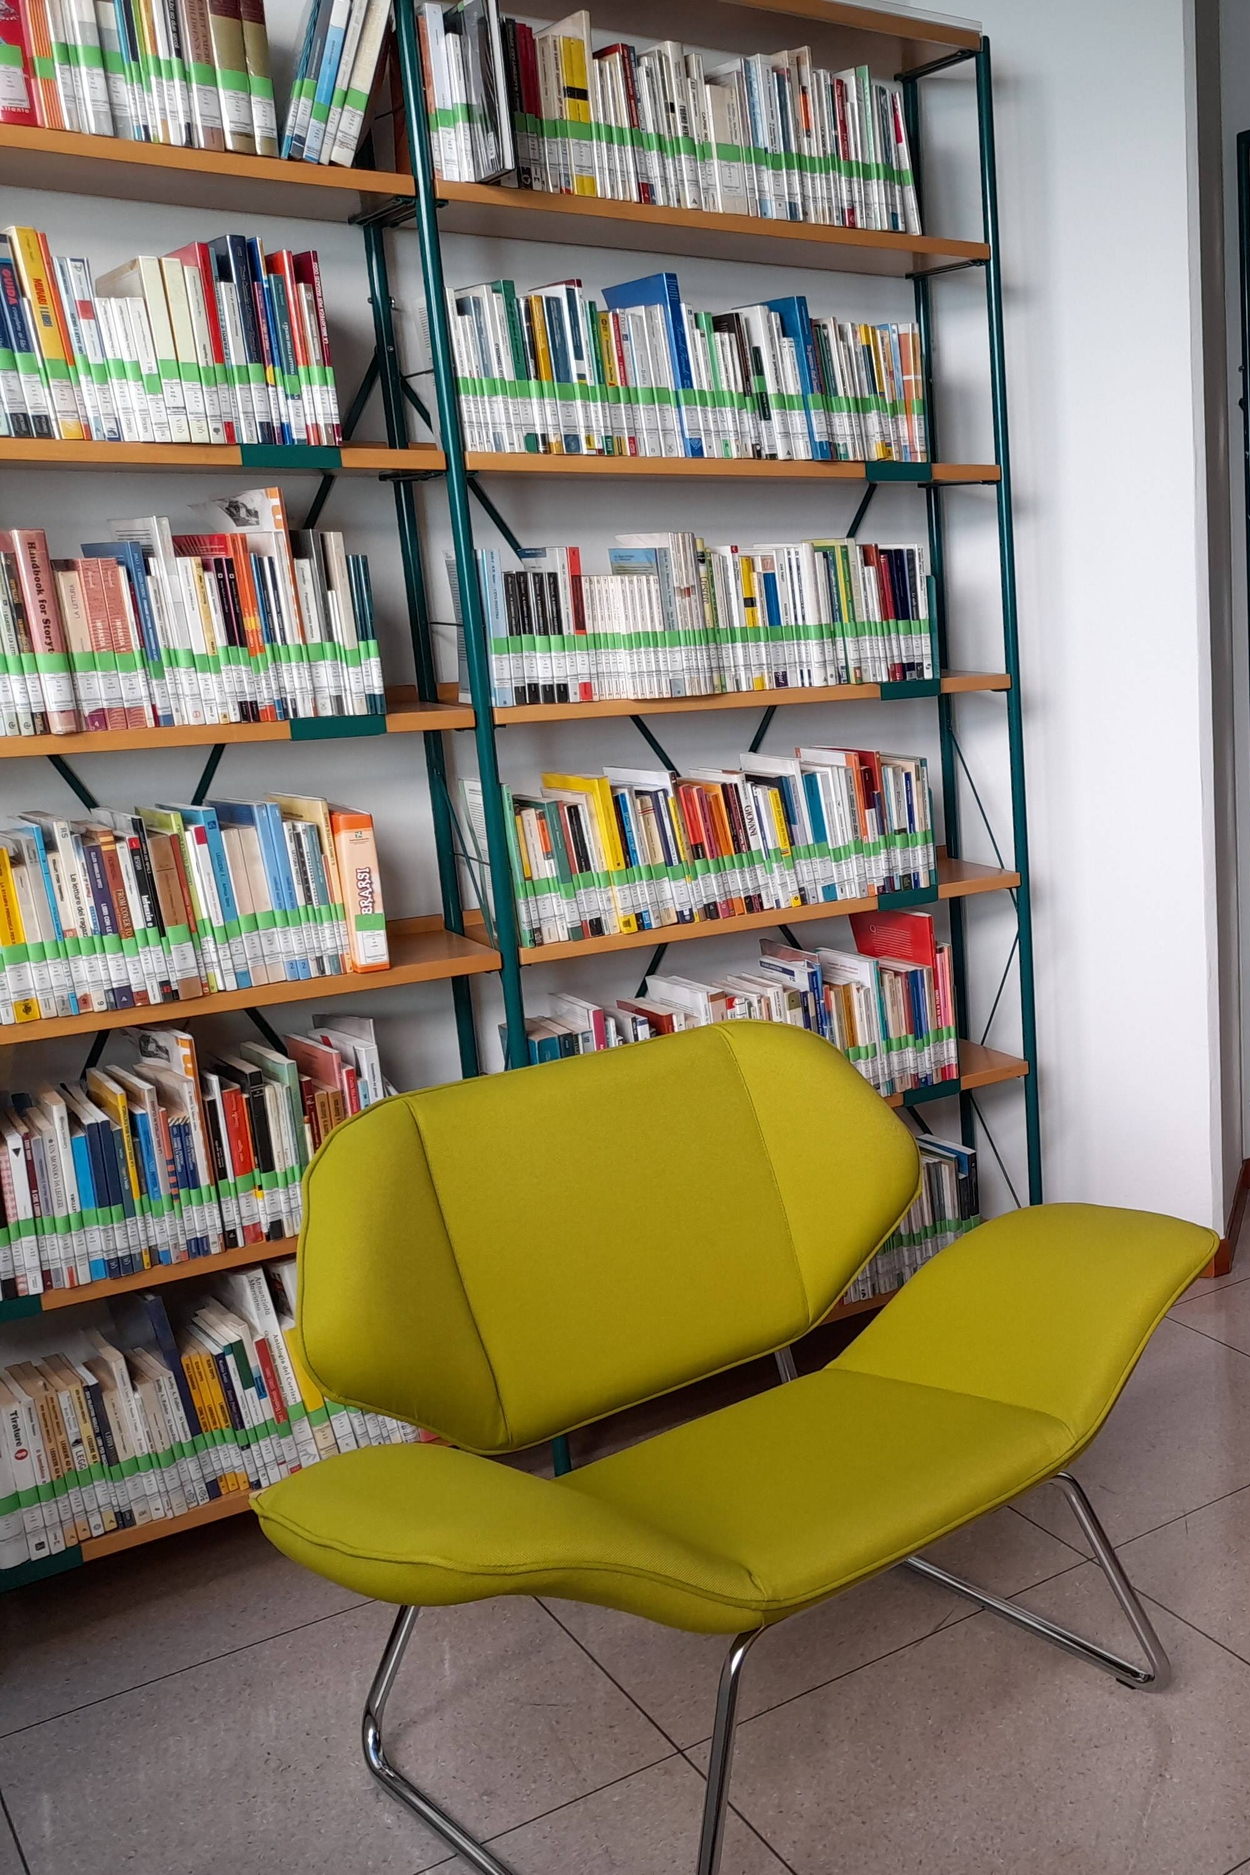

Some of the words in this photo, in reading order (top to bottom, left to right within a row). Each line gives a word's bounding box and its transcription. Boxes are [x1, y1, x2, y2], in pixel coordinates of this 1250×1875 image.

[1, 267, 20, 306] GUIDA
[37, 598, 48, 616] for
[741, 804, 759, 837] GIOVANI
[71, 881, 83, 906] letture
[9, 1409, 24, 1448] Tirature
